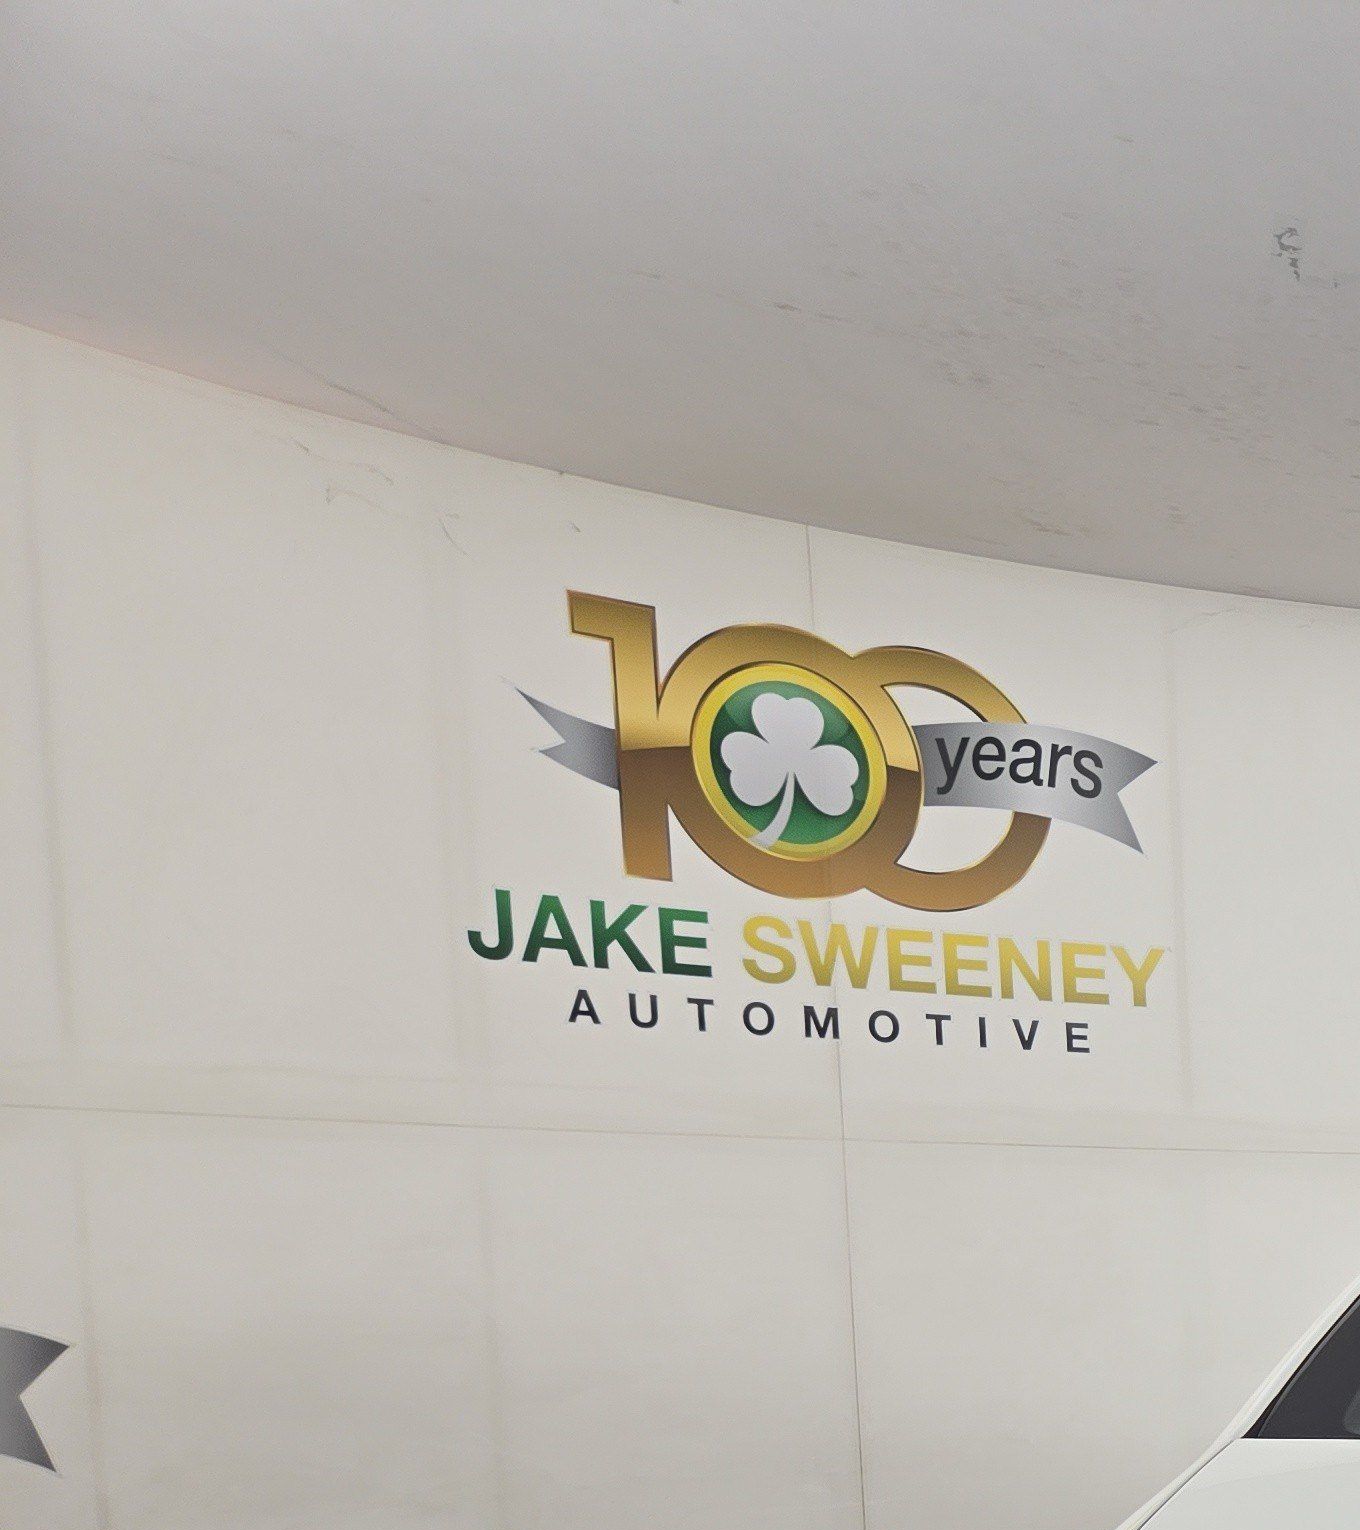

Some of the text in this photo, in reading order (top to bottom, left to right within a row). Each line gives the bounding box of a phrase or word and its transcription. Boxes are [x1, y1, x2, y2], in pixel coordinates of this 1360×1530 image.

[934, 734, 1104, 798] years
[467, 889, 1165, 1008] JAKE SWEENEY
[568, 989, 1093, 1054] AUTOMOTIVE
